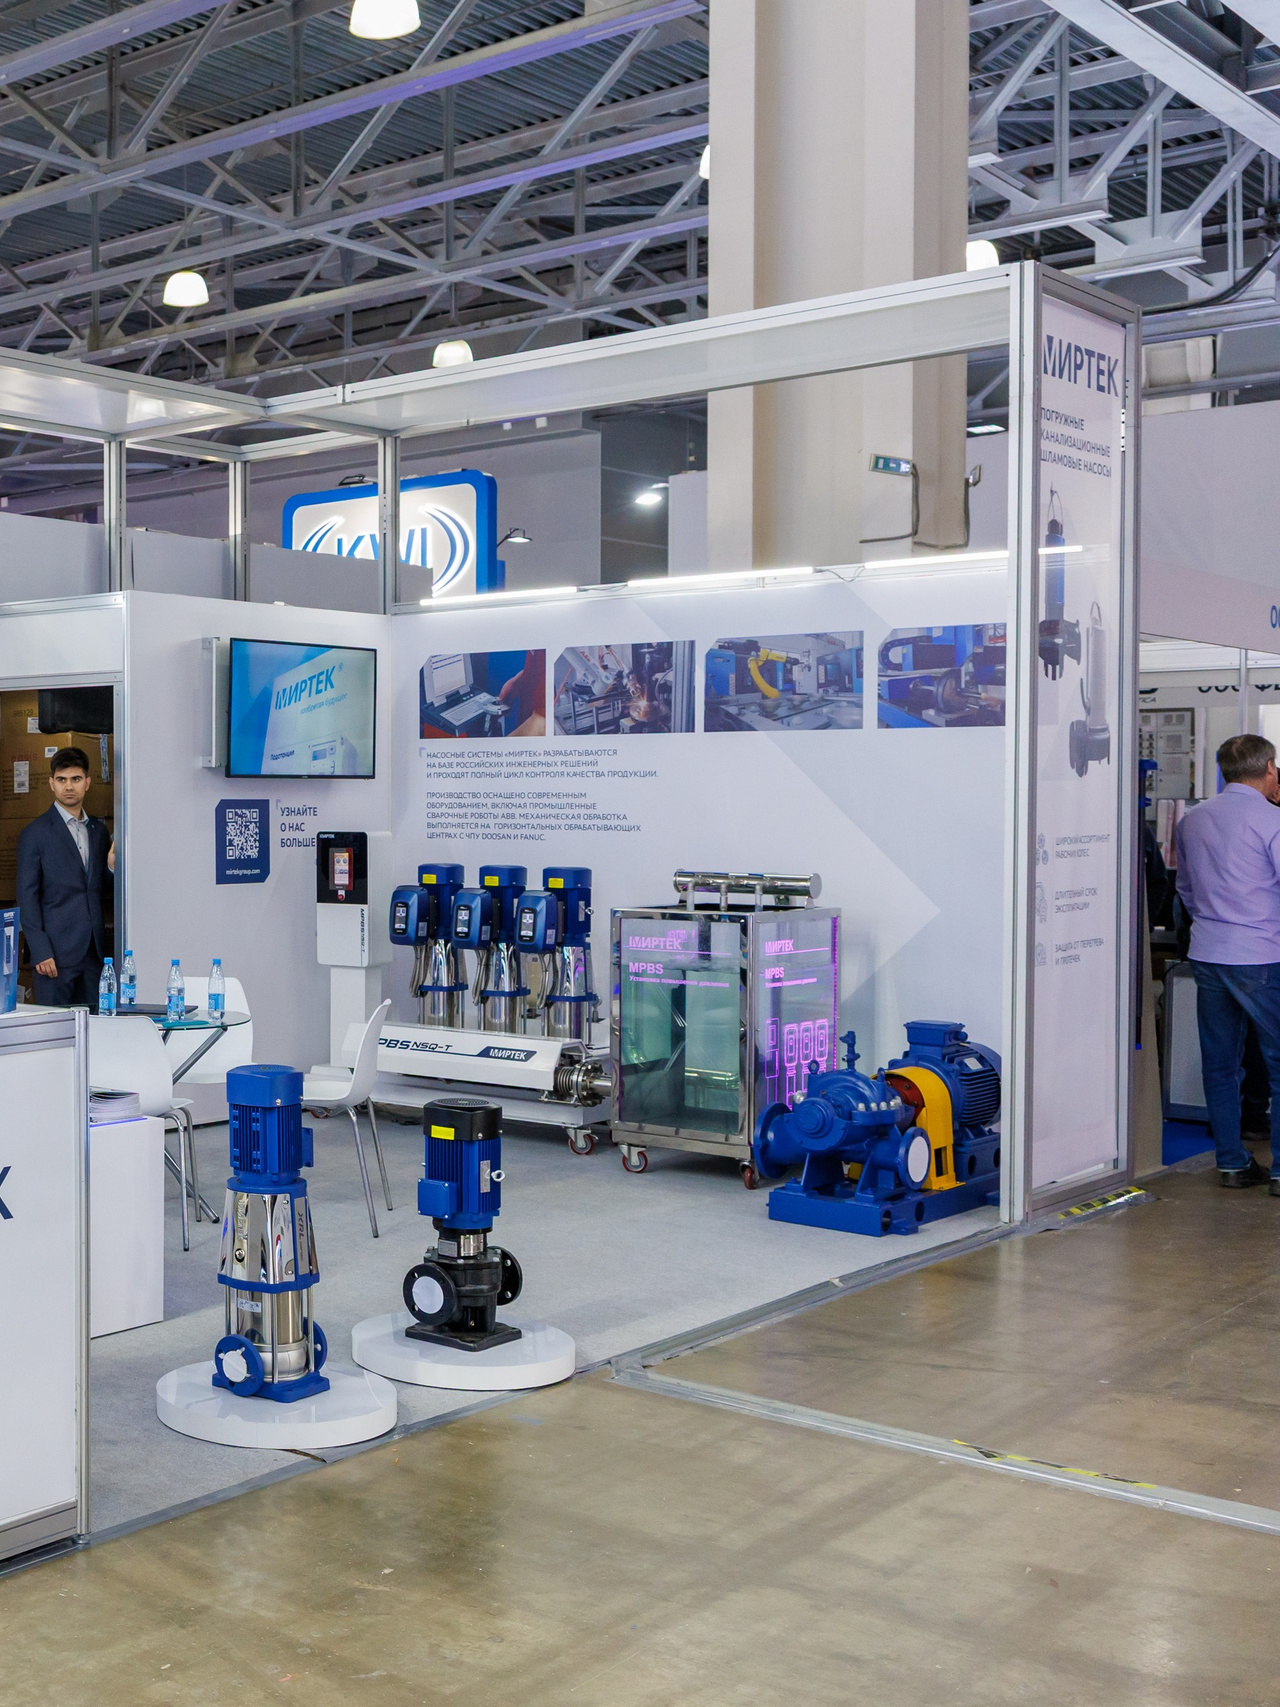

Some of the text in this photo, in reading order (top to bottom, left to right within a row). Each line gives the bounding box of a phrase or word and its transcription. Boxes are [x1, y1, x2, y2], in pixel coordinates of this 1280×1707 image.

[1043, 334, 1119, 397] МИРТЕК
[1041, 407, 1084, 431] ПОГРУЖНЫЕ
[1041, 429, 1110, 458] КАНАЛИЗАЦИОННЫЕ
[1040, 449, 1111, 477] ШЛАМОВЫЕ НАСОСЫ
[275, 666, 336, 710] МИРТЕК
[543, 749, 617, 757] РАЗРАБАТЫВАЮТСЯ
[456, 760, 504, 768] РОССИЙСКИХ
[506, 760, 558, 768] ИНЖЕНЕРНЫХ
[561, 759, 598, 767] РЕШЕНИЙ
[433, 771, 469, 779] ПРОХОДЯТ
[471, 770, 501, 778] ПОЛНЫЙ
[503, 771, 524, 779] ЦИКЛ
[567, 770, 605, 778] КАЧЕСТВА
[607, 770, 659, 779] ПРОДУКЦИИ.
[427, 792, 481, 800] ПРОИЗВОДСТВО
[483, 792, 525, 800] ОСНАЩЕНО
[280, 805, 317, 817] УЗНАЙТЕ
[427, 802, 489, 810] ОБОРУДОВАНИЕМ,
[280, 823, 305, 832] О НАС
[564, 824, 641, 832] ОБРАБАТЫВАЮЩИХ
[427, 832, 458, 840] ЦЕНТРАХ
[280, 838, 315, 847] БОЛЬШЕ
[629, 936, 682, 950] МИРТЕК
[629, 962, 663, 974] MPBS
[378, 1038, 453, 1051] PBS NSQ-T
[490, 1049, 527, 1060] МИРТЕК
